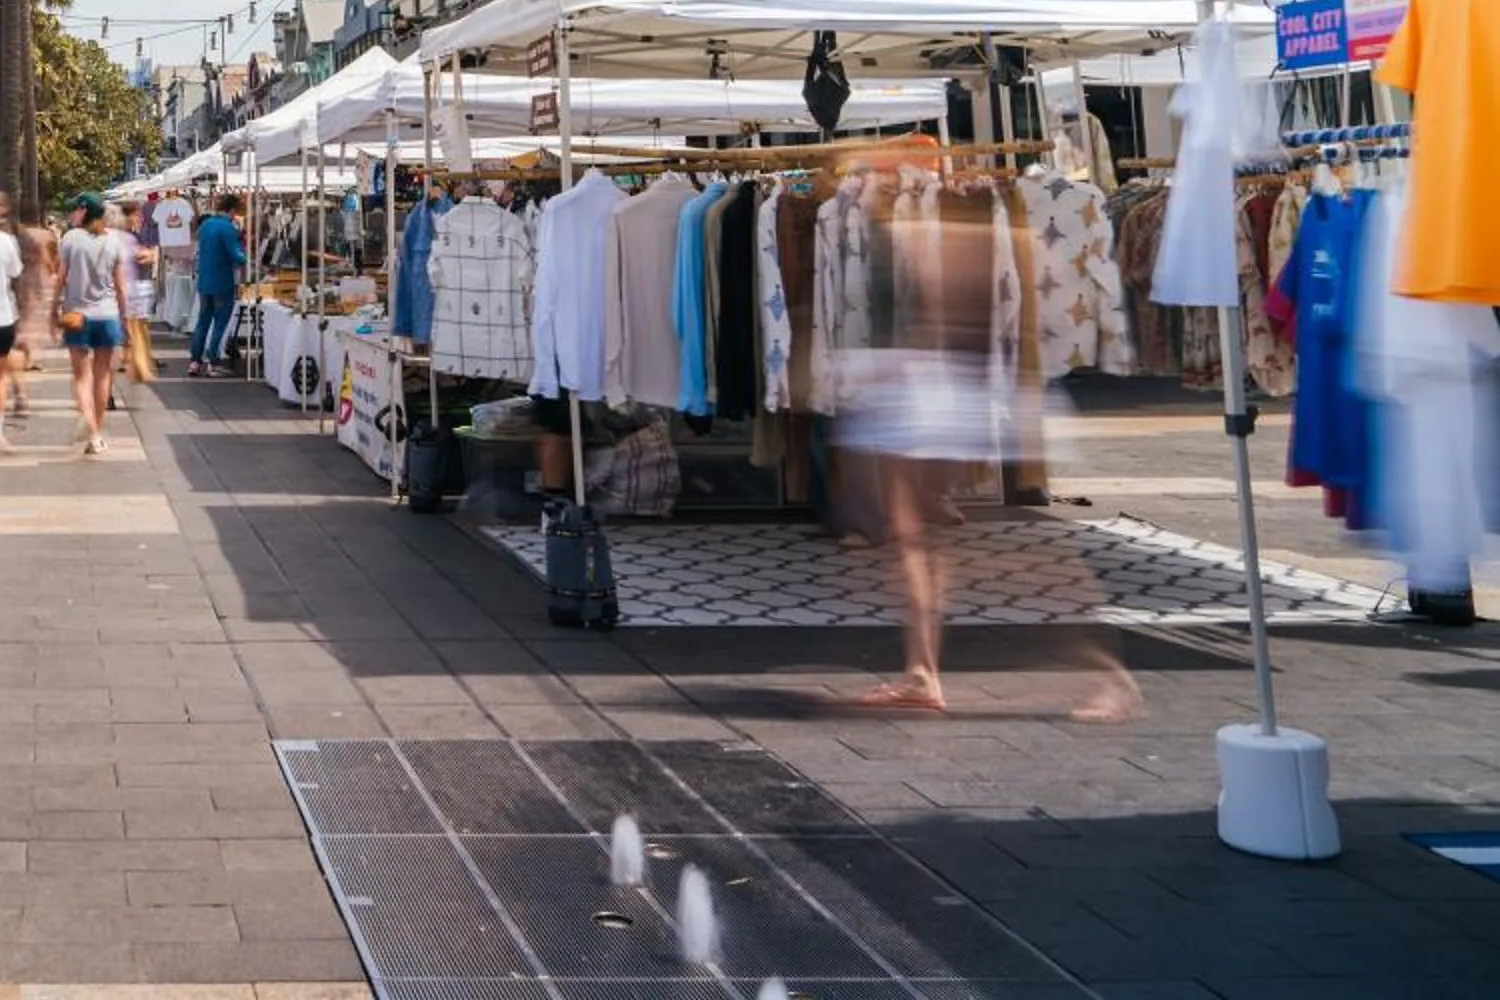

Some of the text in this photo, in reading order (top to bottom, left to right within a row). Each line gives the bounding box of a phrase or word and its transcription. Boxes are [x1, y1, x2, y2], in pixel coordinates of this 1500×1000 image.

[1279, 15, 1309, 36] COOL
[1312, 8, 1342, 31] CITY
[1284, 32, 1340, 57] APPAREL
